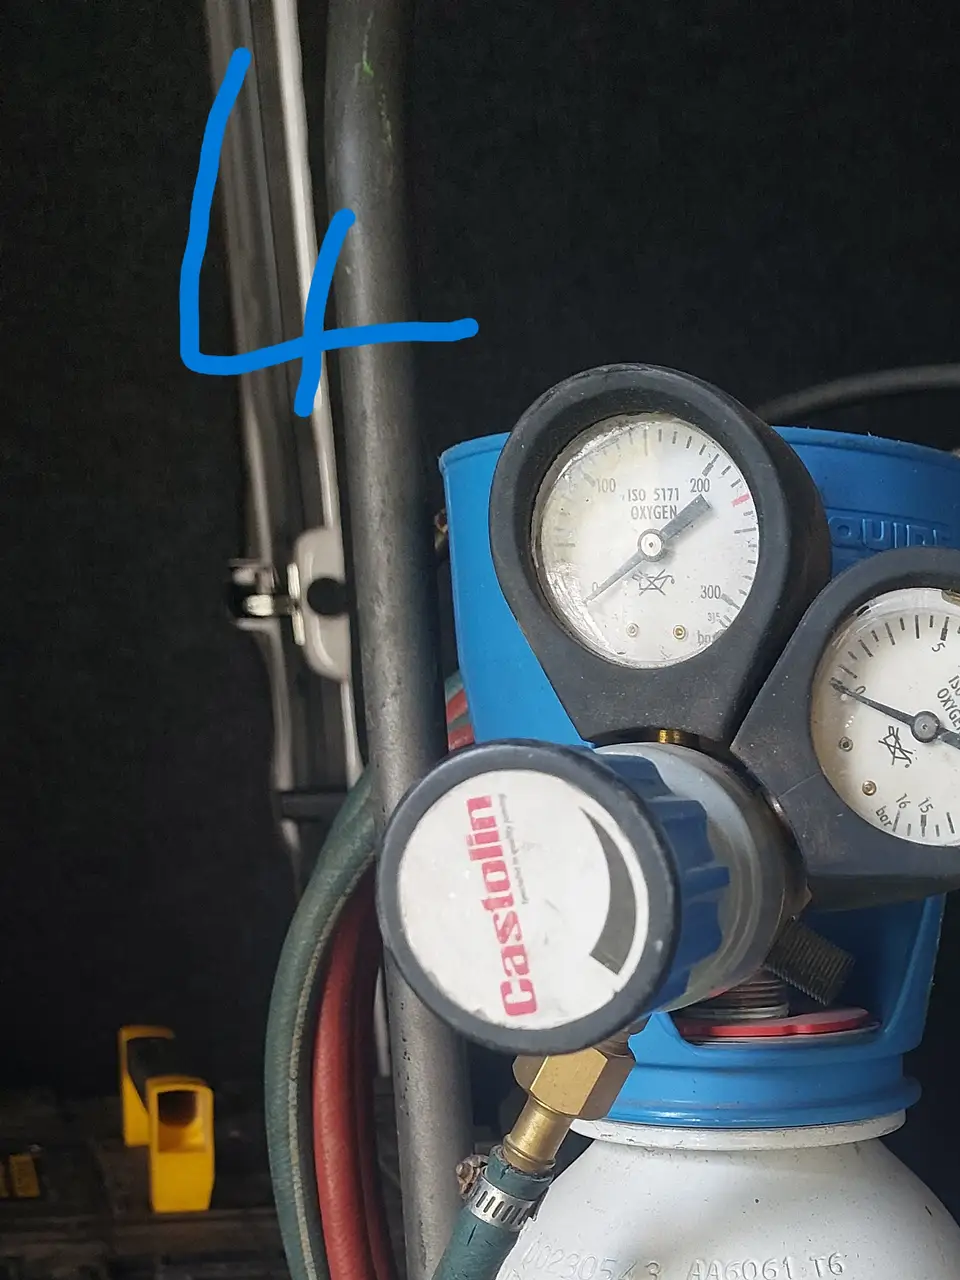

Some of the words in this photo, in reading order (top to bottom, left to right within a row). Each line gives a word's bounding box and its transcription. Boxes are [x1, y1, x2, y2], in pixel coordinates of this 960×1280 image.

[596, 478, 616, 493] 100
[690, 478, 710, 493] 200
[628, 488, 646, 502] ISO
[653, 488, 679, 501] 5171
[631, 504, 678, 520] OXYGEN
[700, 584, 721, 600] 300
[931, 642, 945, 653] 5
[896, 792, 911, 809] 16
[918, 796, 934, 814] 15
[875, 805, 893, 827] bar
[464, 795, 539, 1017] Castolin
[809, 1252, 845, 1278] T6
